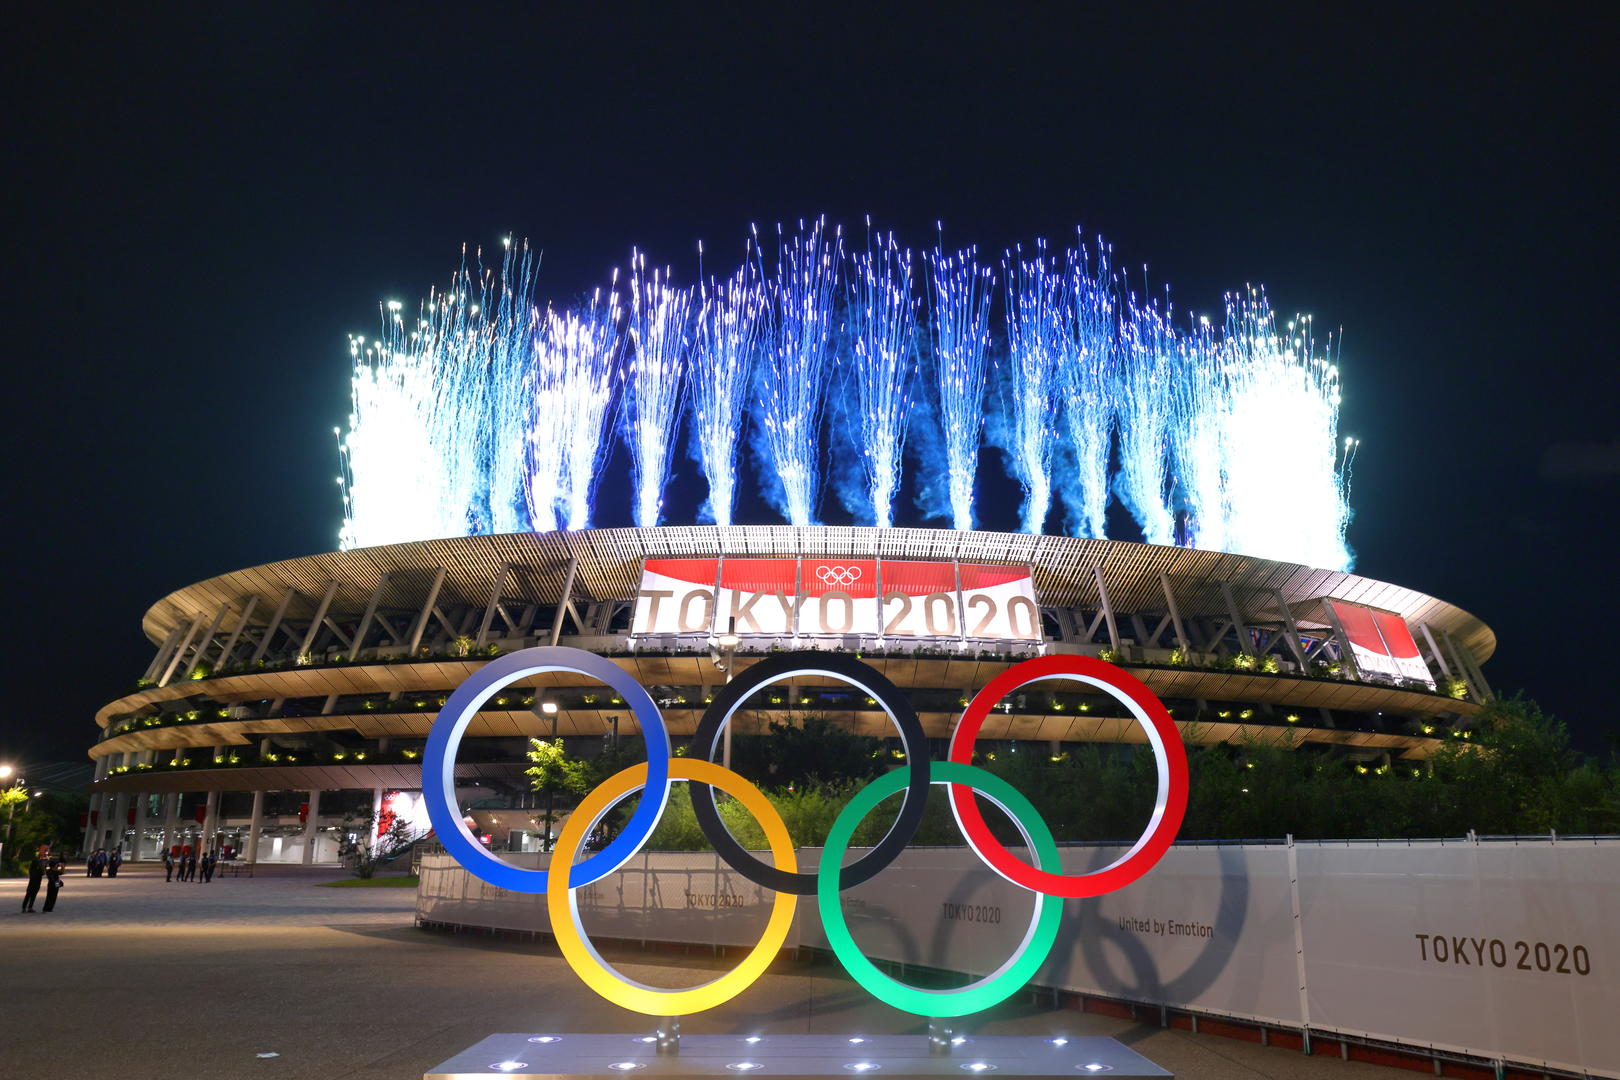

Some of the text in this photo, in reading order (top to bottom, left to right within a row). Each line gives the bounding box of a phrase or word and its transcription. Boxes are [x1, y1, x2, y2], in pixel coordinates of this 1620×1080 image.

[638, 588, 1040, 640] TOKYO 2020
[685, 893, 745, 908] TOKYO 2020
[942, 902, 1001, 924] TOKYO 2020
[1119, 916, 1214, 938] United by Emotion
[1415, 933, 1591, 976] TOKYO 2020
